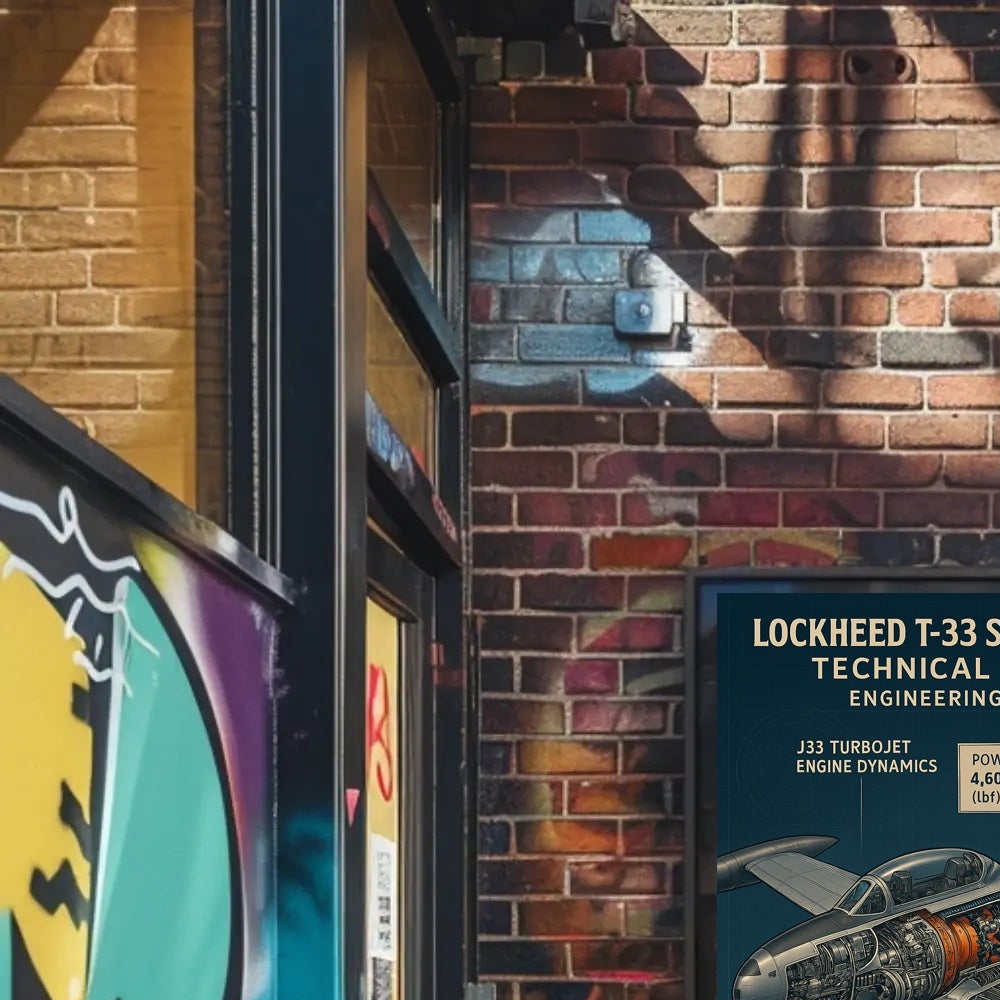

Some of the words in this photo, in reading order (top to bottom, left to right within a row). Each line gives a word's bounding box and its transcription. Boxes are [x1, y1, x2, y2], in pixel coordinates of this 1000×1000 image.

[753, 617, 906, 647] LOCKHEED
[914, 617, 977, 647] T-33
[811, 656, 990, 680] TECHNICAL
[796, 740, 824, 755] J33
[829, 739, 912, 755] TURBOJET
[796, 759, 852, 774] ENGINE
[857, 758, 938, 773] DYNAMICS
[972, 790, 1000, 805] (lbf)
